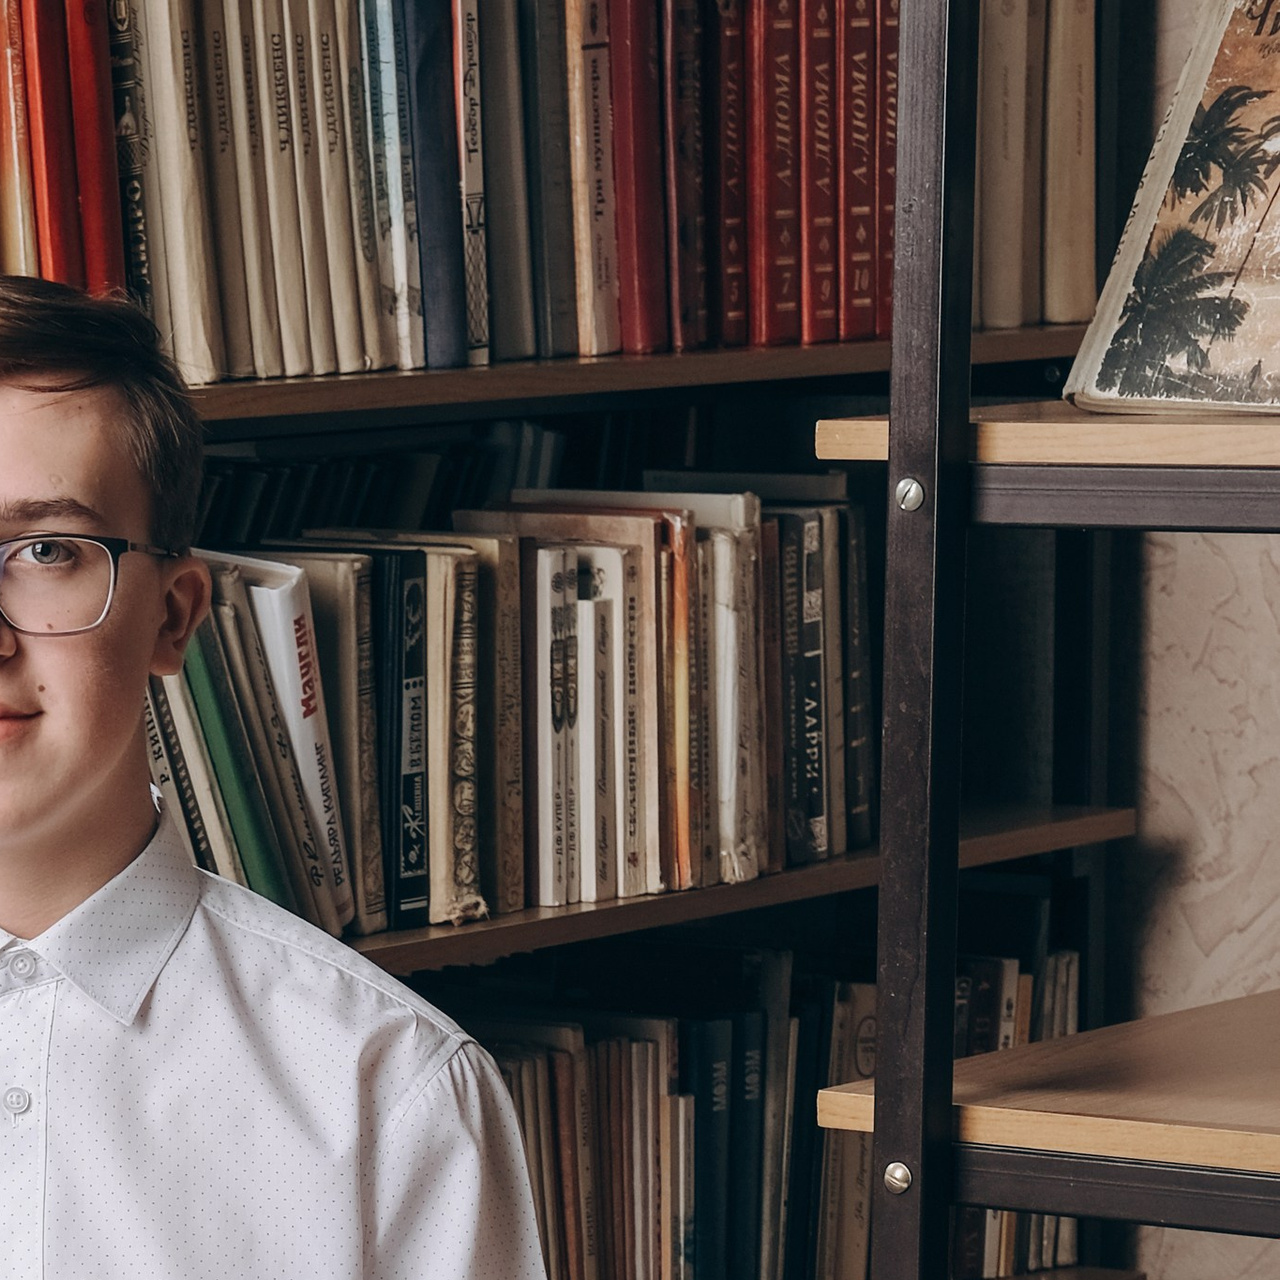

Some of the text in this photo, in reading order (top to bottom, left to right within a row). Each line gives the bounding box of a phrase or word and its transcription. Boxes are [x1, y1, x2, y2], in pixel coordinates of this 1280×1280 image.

[211, 30, 230, 153] Ч.ДИККЕНС
[271, 32, 290, 151] Ч.ДИККЕНС
[294, 33, 312, 155] Ч.ДИККЕНС
[319, 32, 339, 154] Ч.ДИККЕНС
[461, 11, 479, 162] Теодор Драйзер
[588, 58, 604, 221] Три мушкетера
[773, 52, 794, 186] А.ДЮМА
[813, 61, 832, 195] А.ДЮМА
[850, 49, 869, 184] А.ДЮМА
[781, 272, 792, 295] 7
[853, 268, 870, 292] 10
[291, 612, 318, 718] Маугли
[407, 695, 423, 754] БЕЛОМ
[172, 760, 209, 851] МАЛЕНЬКИЕ
[313, 741, 346, 886] РЕДЬЯРД КИПЛИНГ
